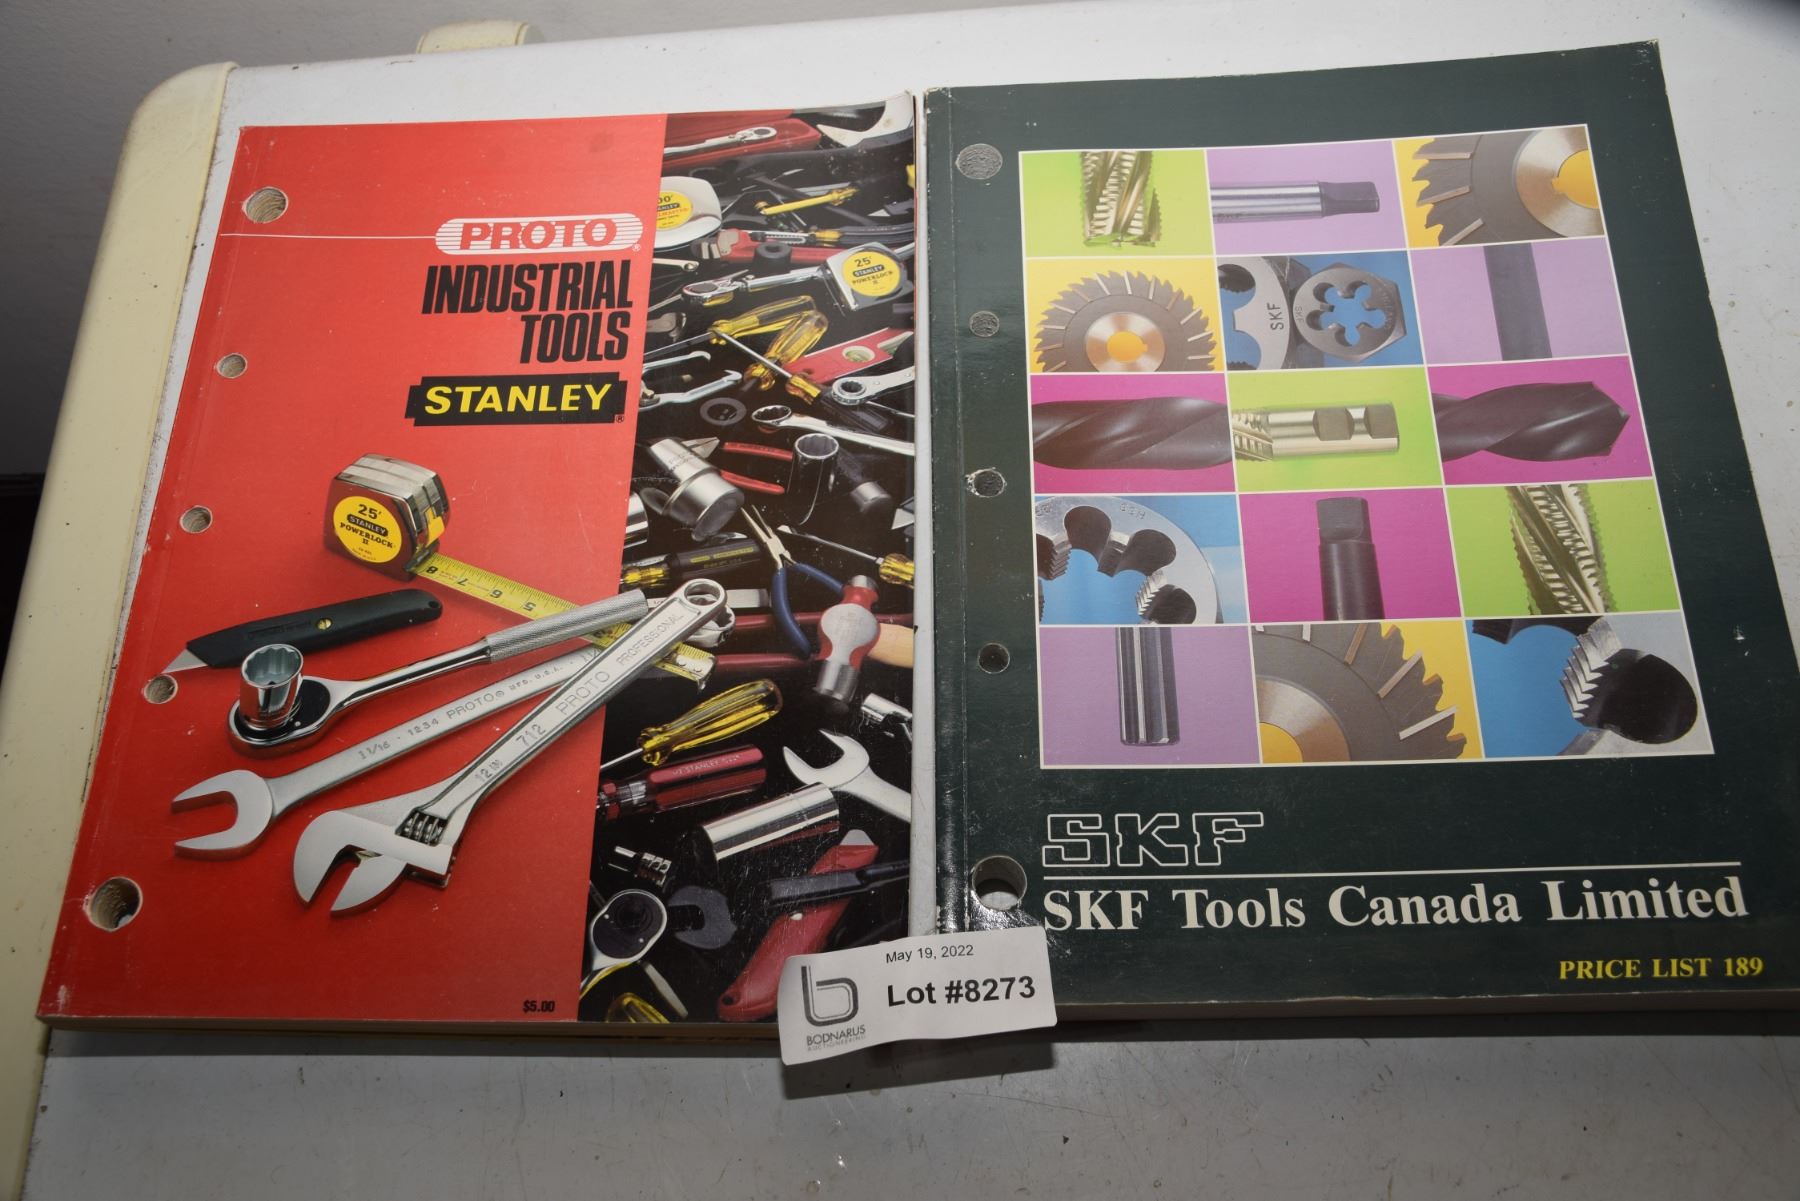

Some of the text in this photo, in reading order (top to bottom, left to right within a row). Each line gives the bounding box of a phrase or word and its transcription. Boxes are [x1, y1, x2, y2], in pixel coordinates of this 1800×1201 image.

[459, 218, 618, 250] PROTO
[854, 265, 883, 277] STANLEY
[421, 259, 633, 314] INDUSTRIAL
[1266, 302, 1285, 330] SKF
[520, 311, 631, 364] TOOLS
[424, 383, 612, 415] STANLEY
[350, 515, 386, 534] STANLEY
[358, 504, 382, 519] 25'
[340, 522, 393, 548] POWERLOCK
[426, 566, 438, 574] 8
[516, 724, 546, 748] 712
[555, 671, 610, 715] PROTO
[616, 613, 685, 666] PROFESSIONAL
[407, 718, 439, 736] 1234
[1042, 811, 1264, 867] SKF
[1043, 876, 1749, 931] SKF Tools Canada Limited
[886, 944, 974, 964] May 19, 2022
[1559, 956, 1764, 980] PRICE LIST 189
[888, 975, 1036, 1007] Lot #8273
[523, 1000, 555, 1013] $5.00
[807, 1024, 866, 1046] BODNARUS
